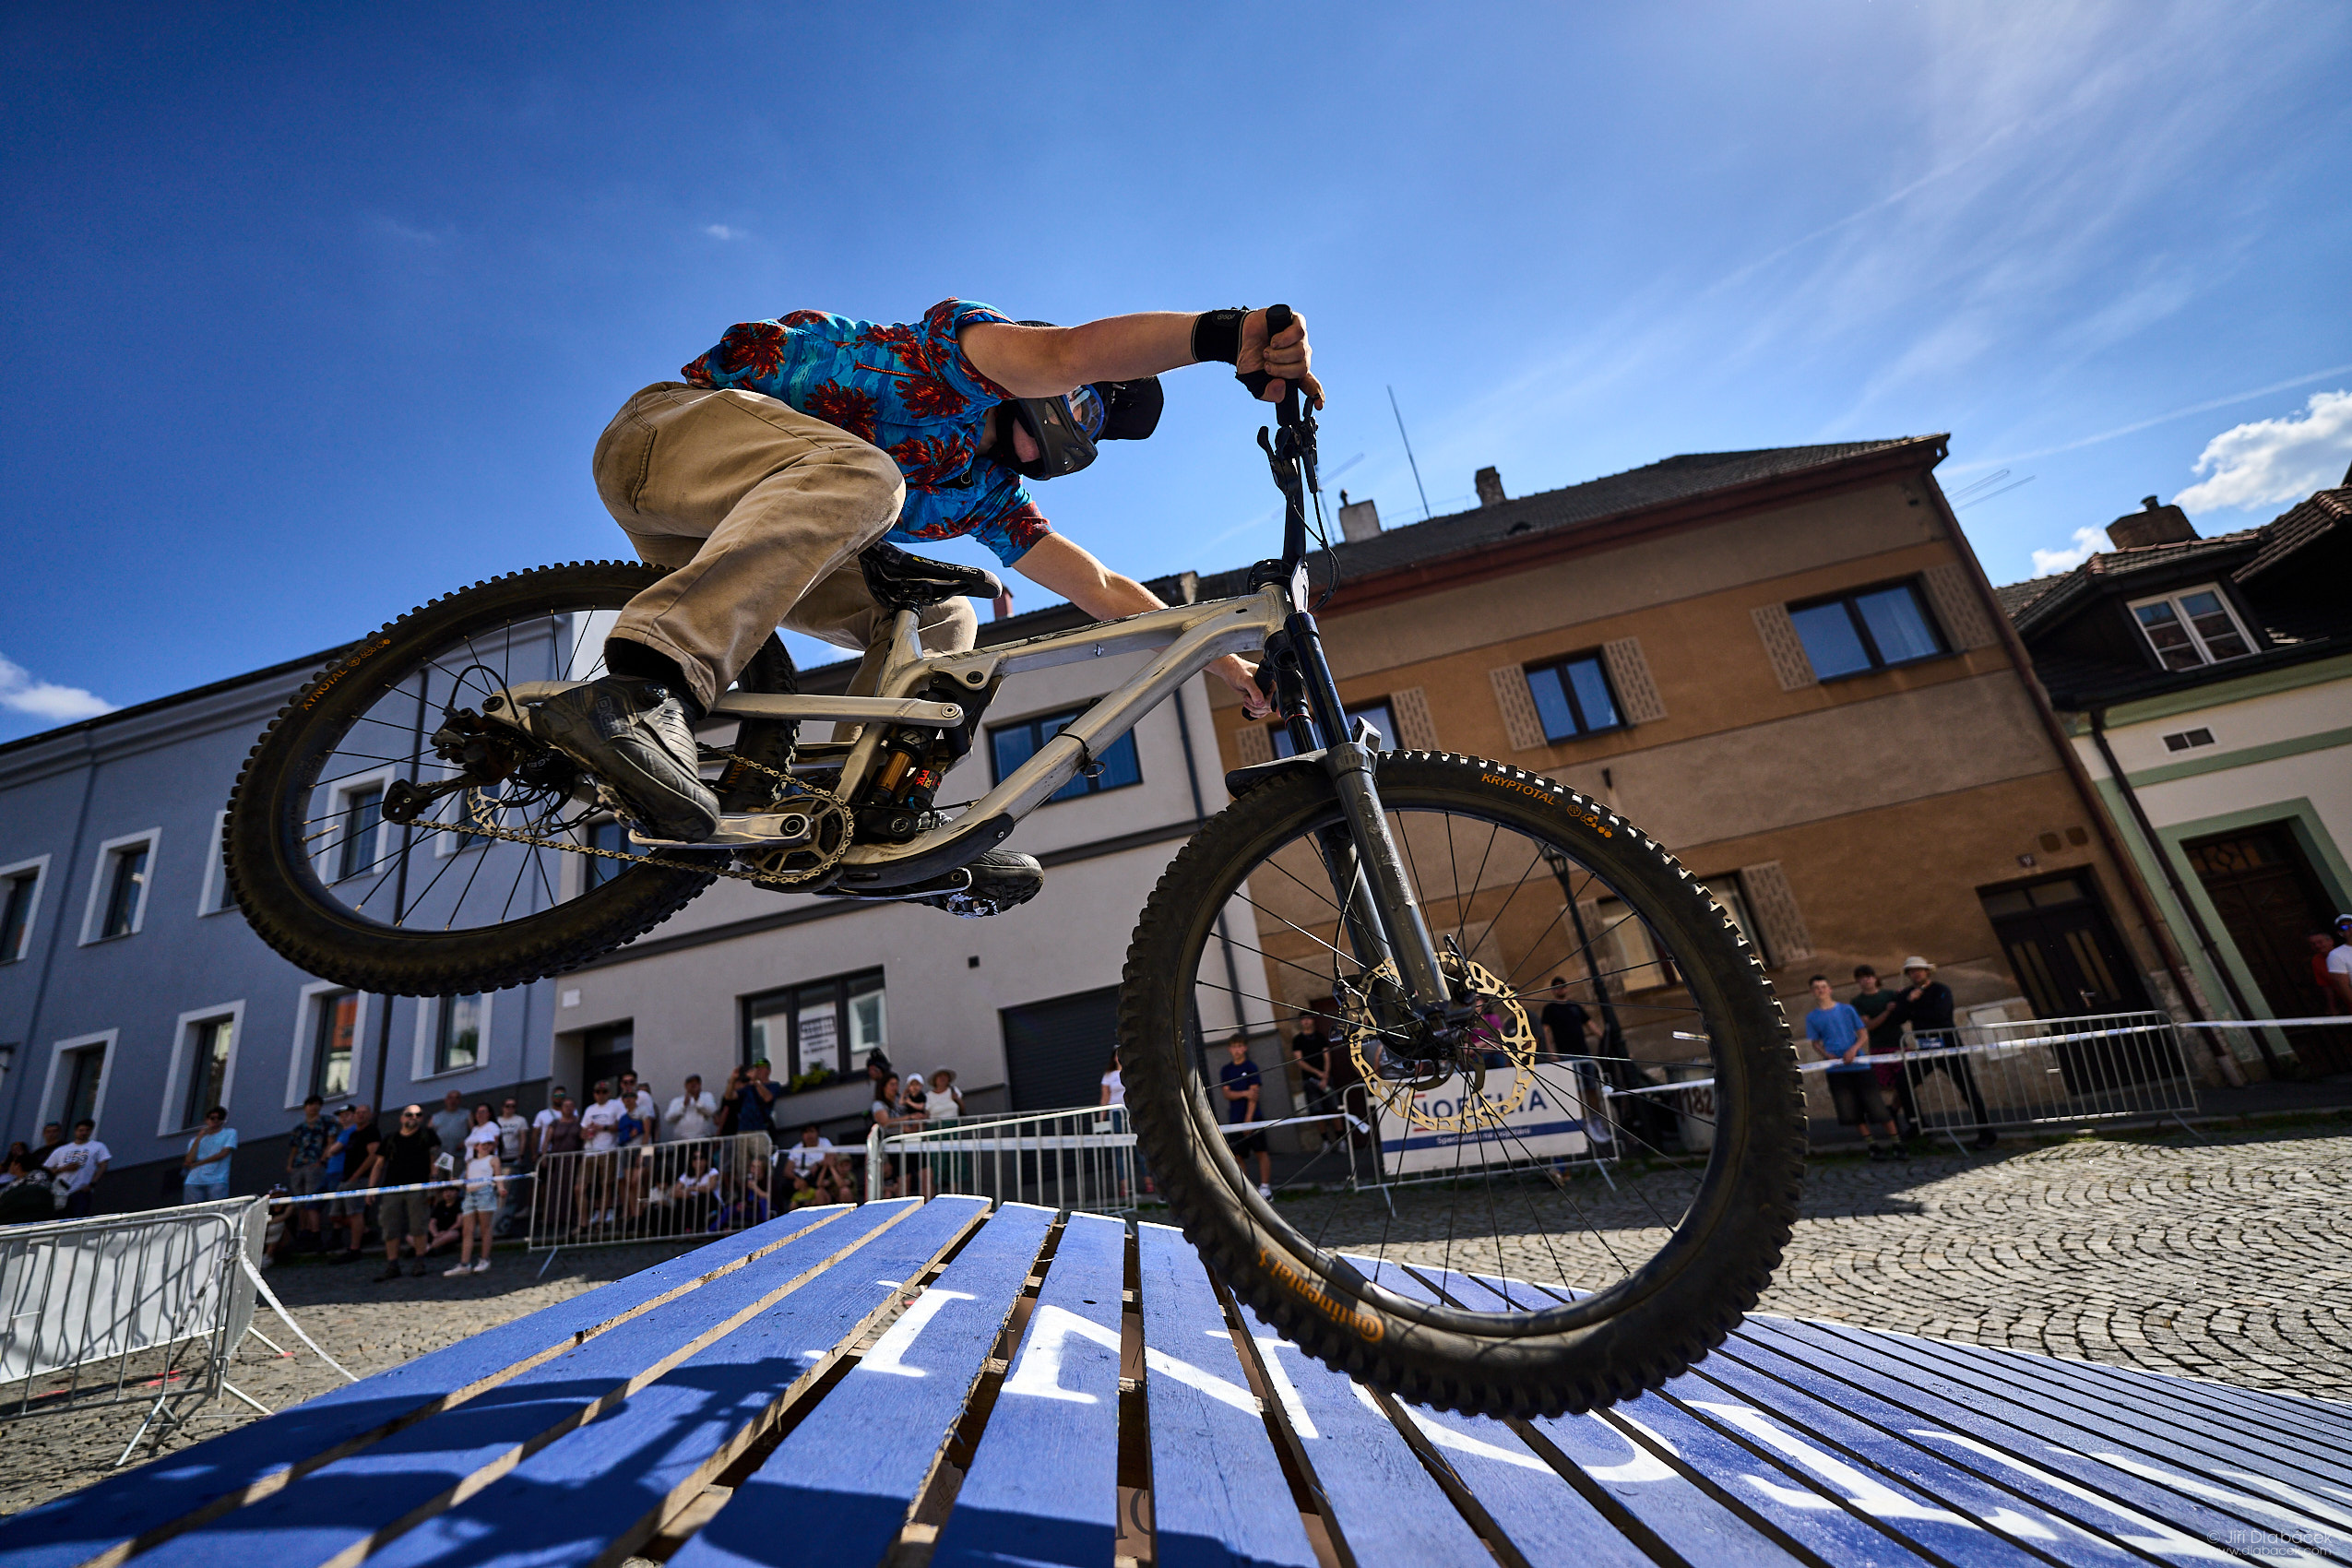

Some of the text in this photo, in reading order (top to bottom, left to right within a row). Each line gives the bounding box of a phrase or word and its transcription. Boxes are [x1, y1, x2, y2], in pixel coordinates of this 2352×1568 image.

[301, 668, 348, 711] XYNOTAL
[915, 769, 931, 787] FOX
[1481, 773, 1556, 805] KRYPTOTAL
